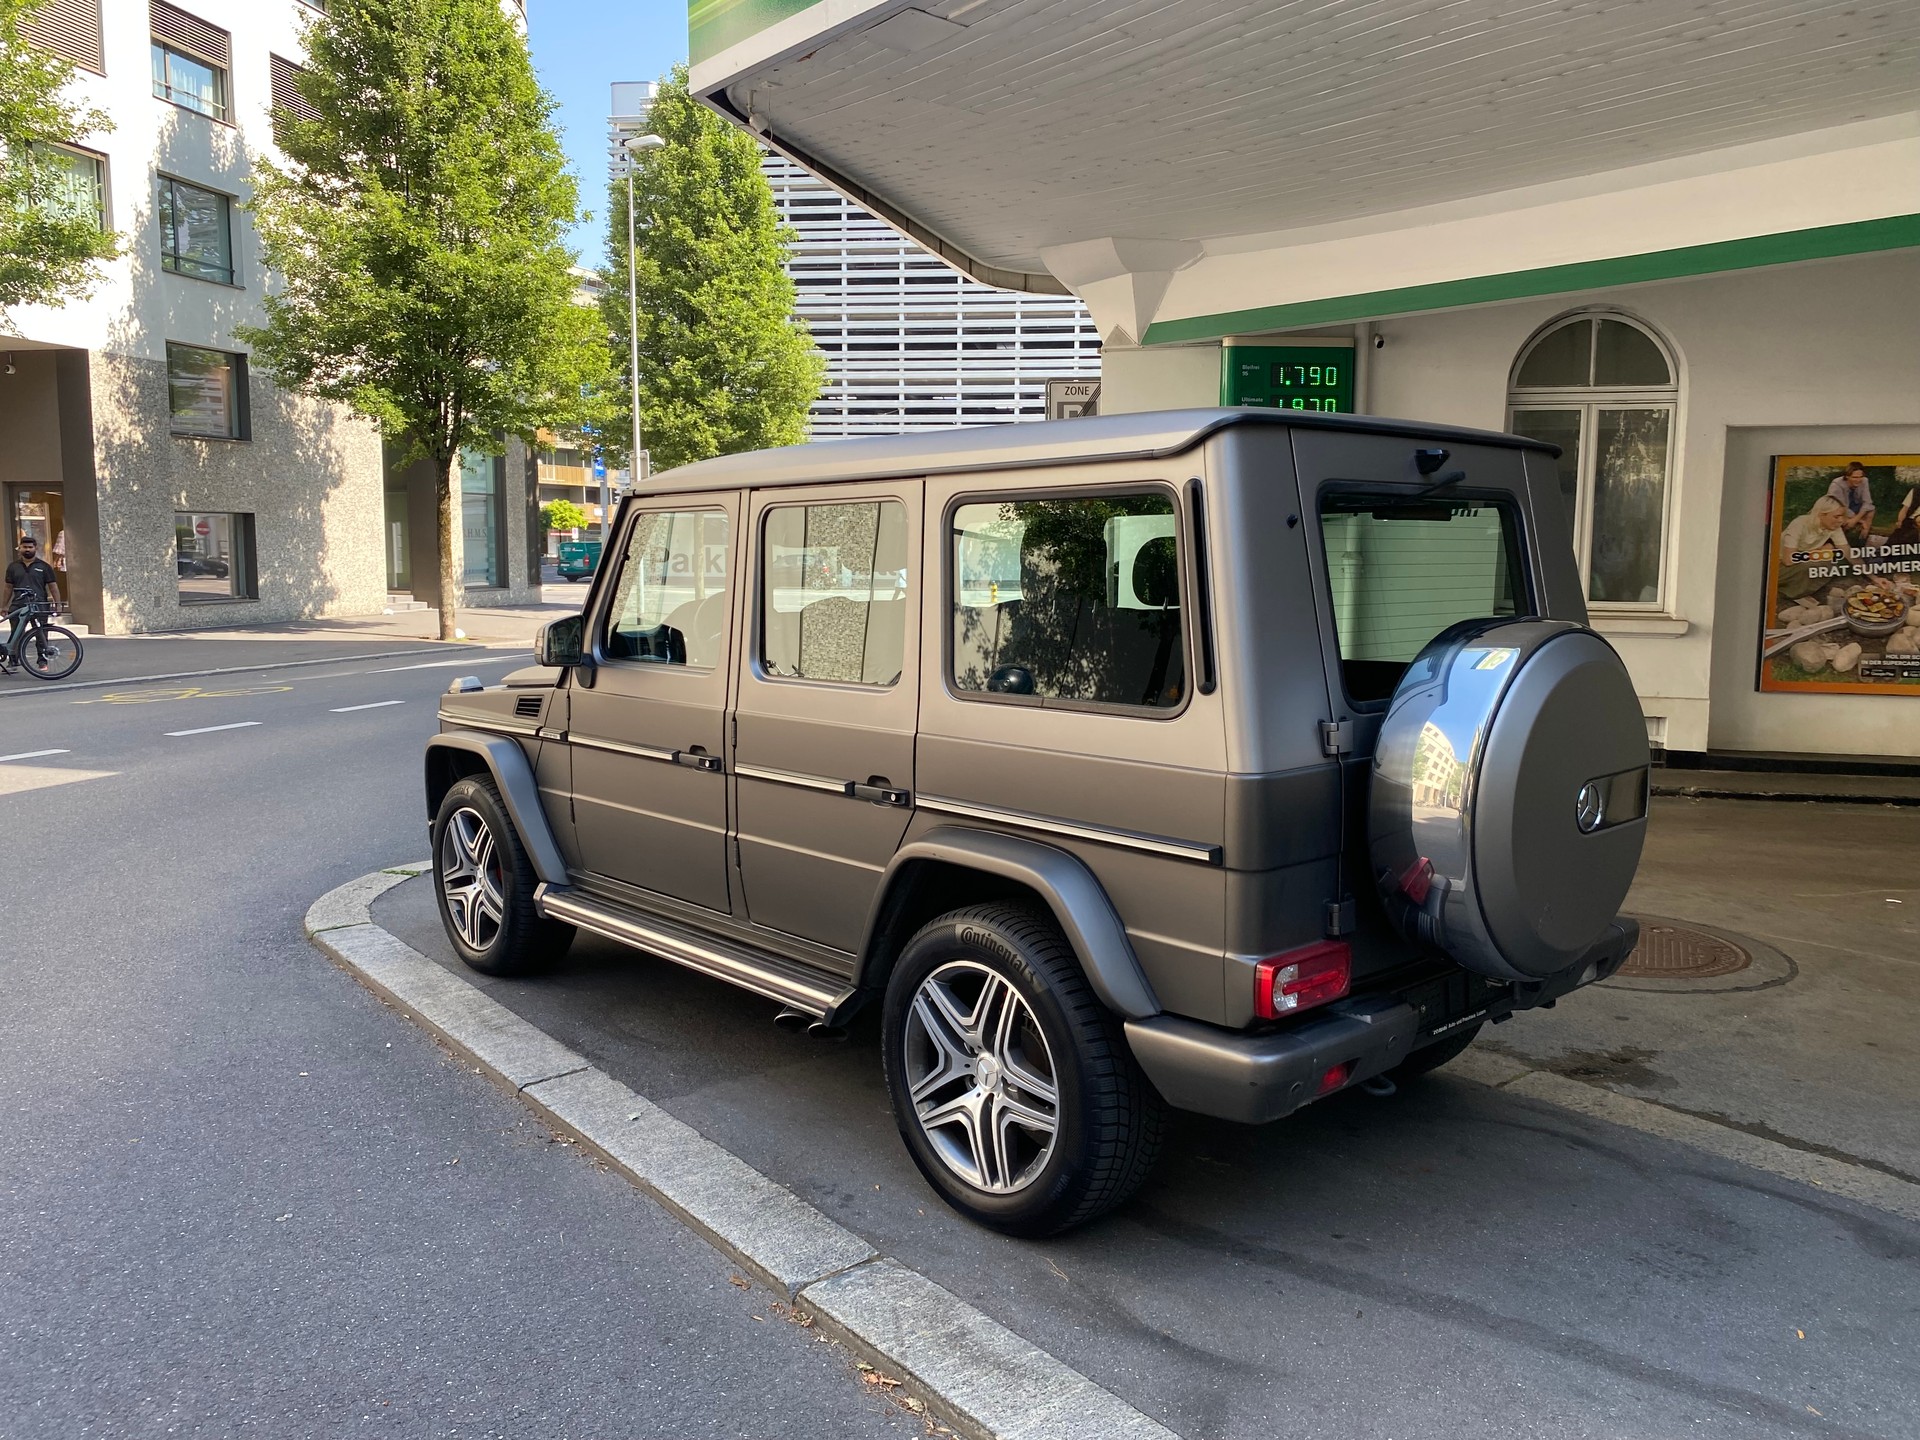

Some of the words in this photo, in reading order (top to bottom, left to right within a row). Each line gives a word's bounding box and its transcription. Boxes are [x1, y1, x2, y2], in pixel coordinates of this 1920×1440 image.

[1279, 366, 1337, 386] 1.790
[1064, 386, 1090, 396] ZONE
[1791, 548, 1844, 564] scoop
[1850, 546, 1877, 559] DIR
[1880, 543, 1920, 558] DEIN
[1809, 565, 1849, 579] BRAT
[1853, 560, 1920, 576] SUMMER
[961, 926, 1029, 976] Continental
